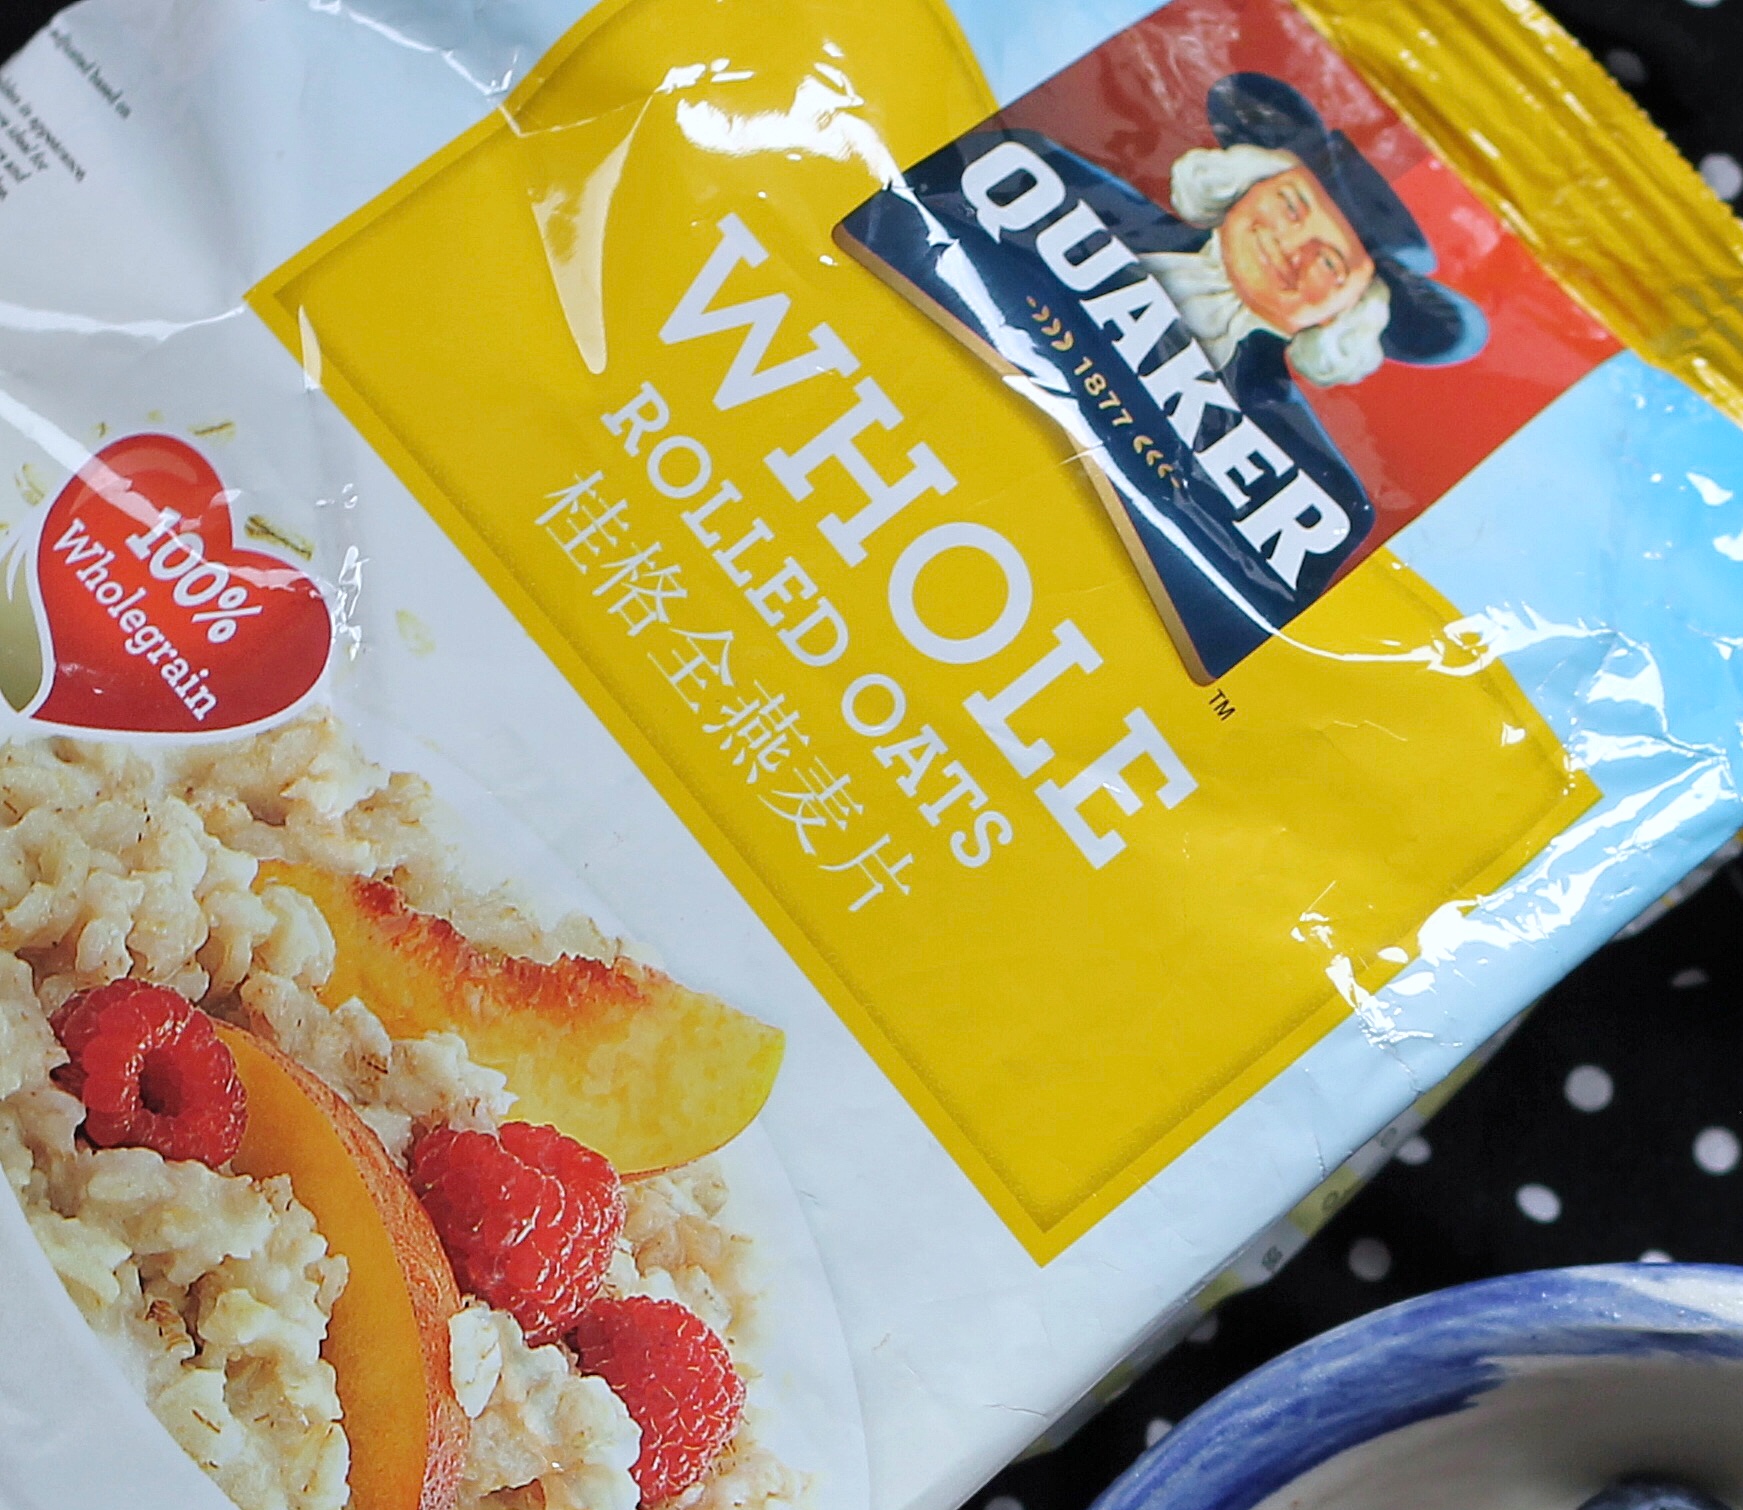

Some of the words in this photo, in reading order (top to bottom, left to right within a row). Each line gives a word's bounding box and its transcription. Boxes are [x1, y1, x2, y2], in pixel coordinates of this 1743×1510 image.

[125, 506, 263, 643] 100%
[658, 212, 1198, 870] WHOLE
[961, 141, 1351, 590] QUAKER
[1073, 356, 1133, 428] 1877
[53, 518, 217, 721] Wholegrain
[534, 469, 913, 912] 桂格全燕麦片
[601, 381, 849, 667] ROLLED
[841, 673, 1014, 868] OATS
